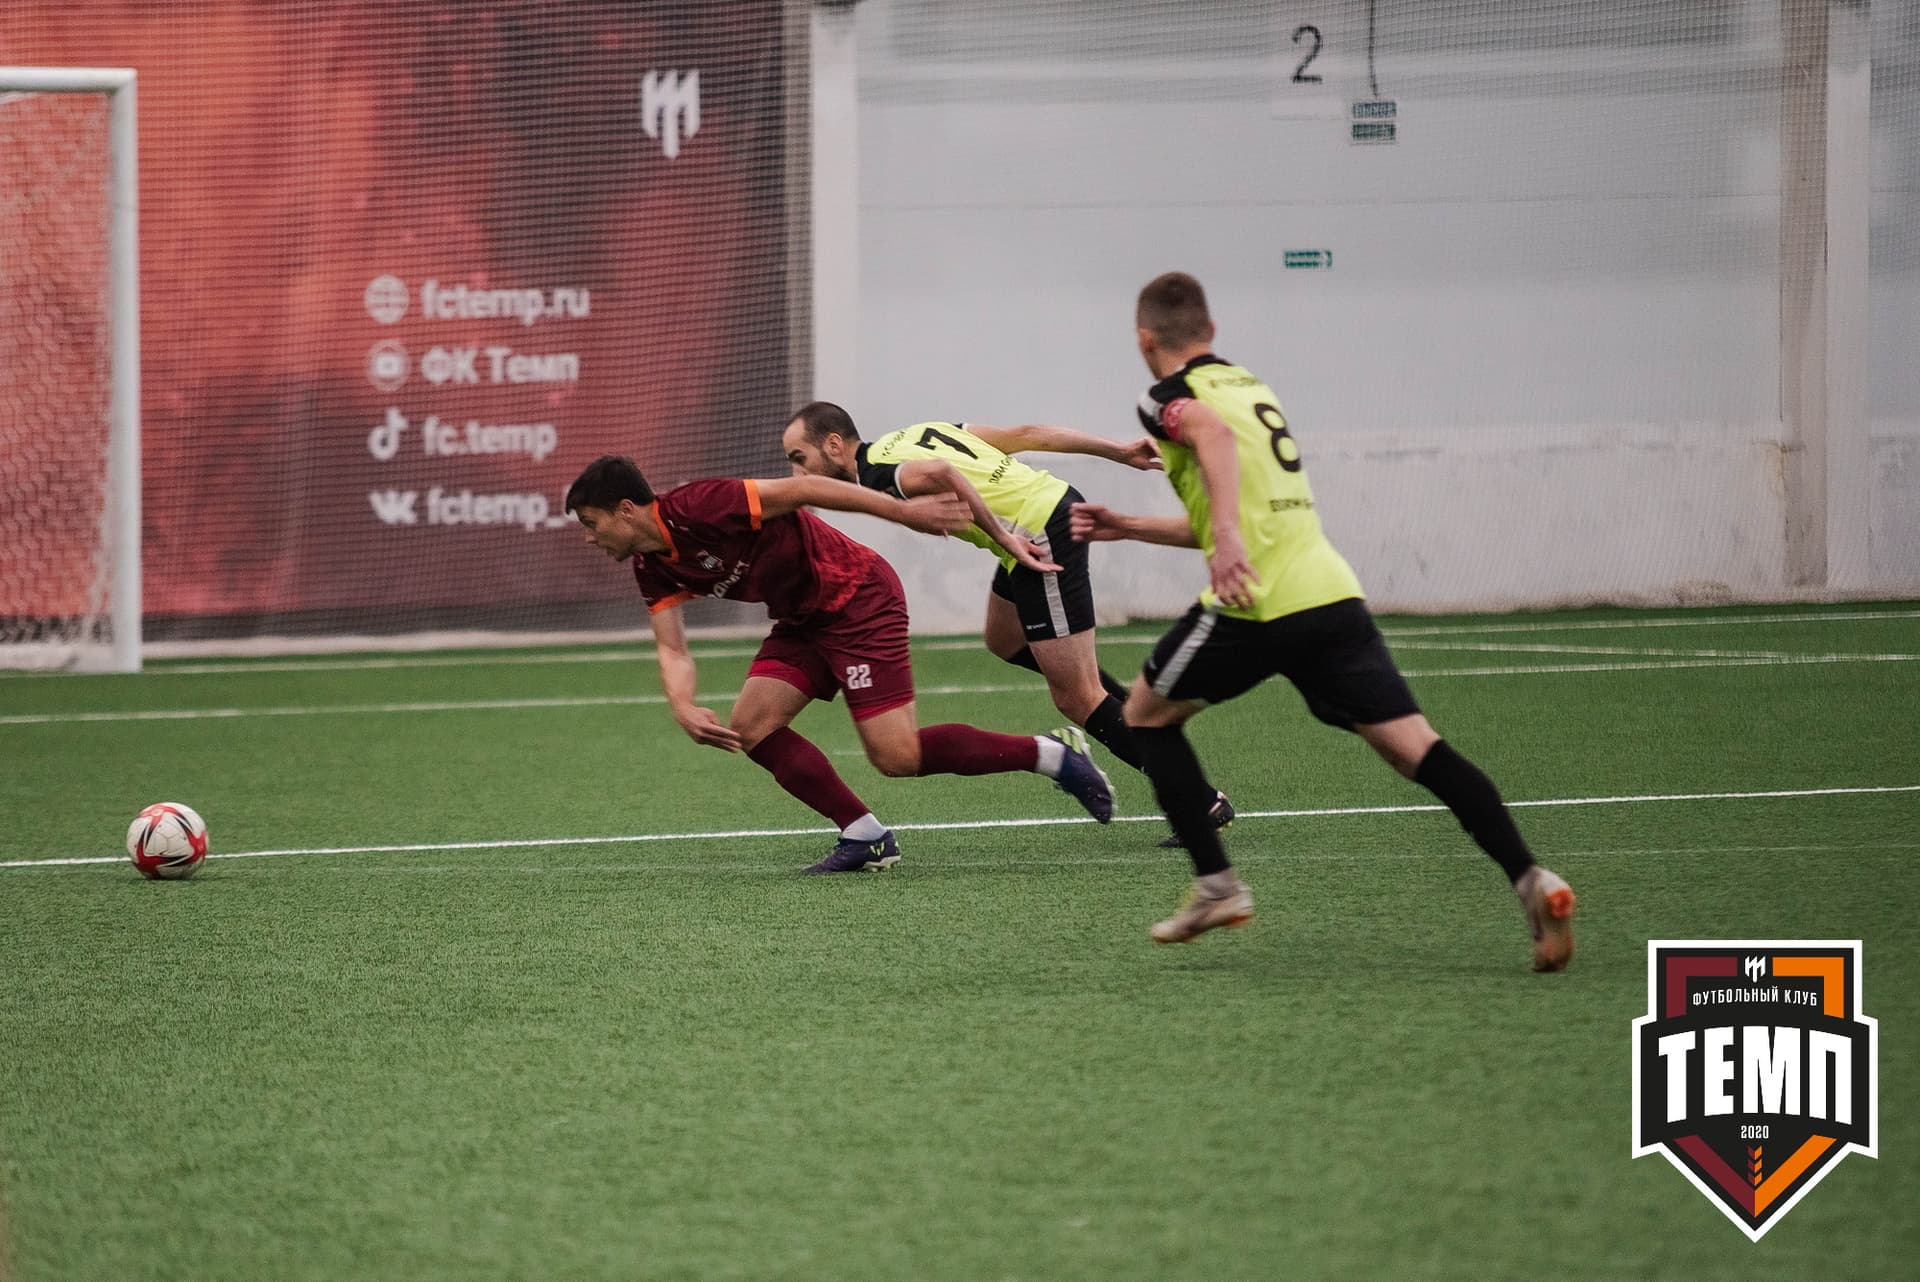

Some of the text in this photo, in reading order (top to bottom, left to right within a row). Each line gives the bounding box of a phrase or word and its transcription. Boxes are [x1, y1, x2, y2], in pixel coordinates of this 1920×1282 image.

[1292, 25, 1323, 84] 2
[422, 279, 590, 327] fctemp.ru
[421, 346, 581, 384] ФК Темп
[423, 416, 558, 462] fc.temp
[915, 427, 979, 460] 7
[1254, 403, 1302, 473] 8
[426, 485, 580, 533] fctemp_
[846, 664, 873, 690] 22
